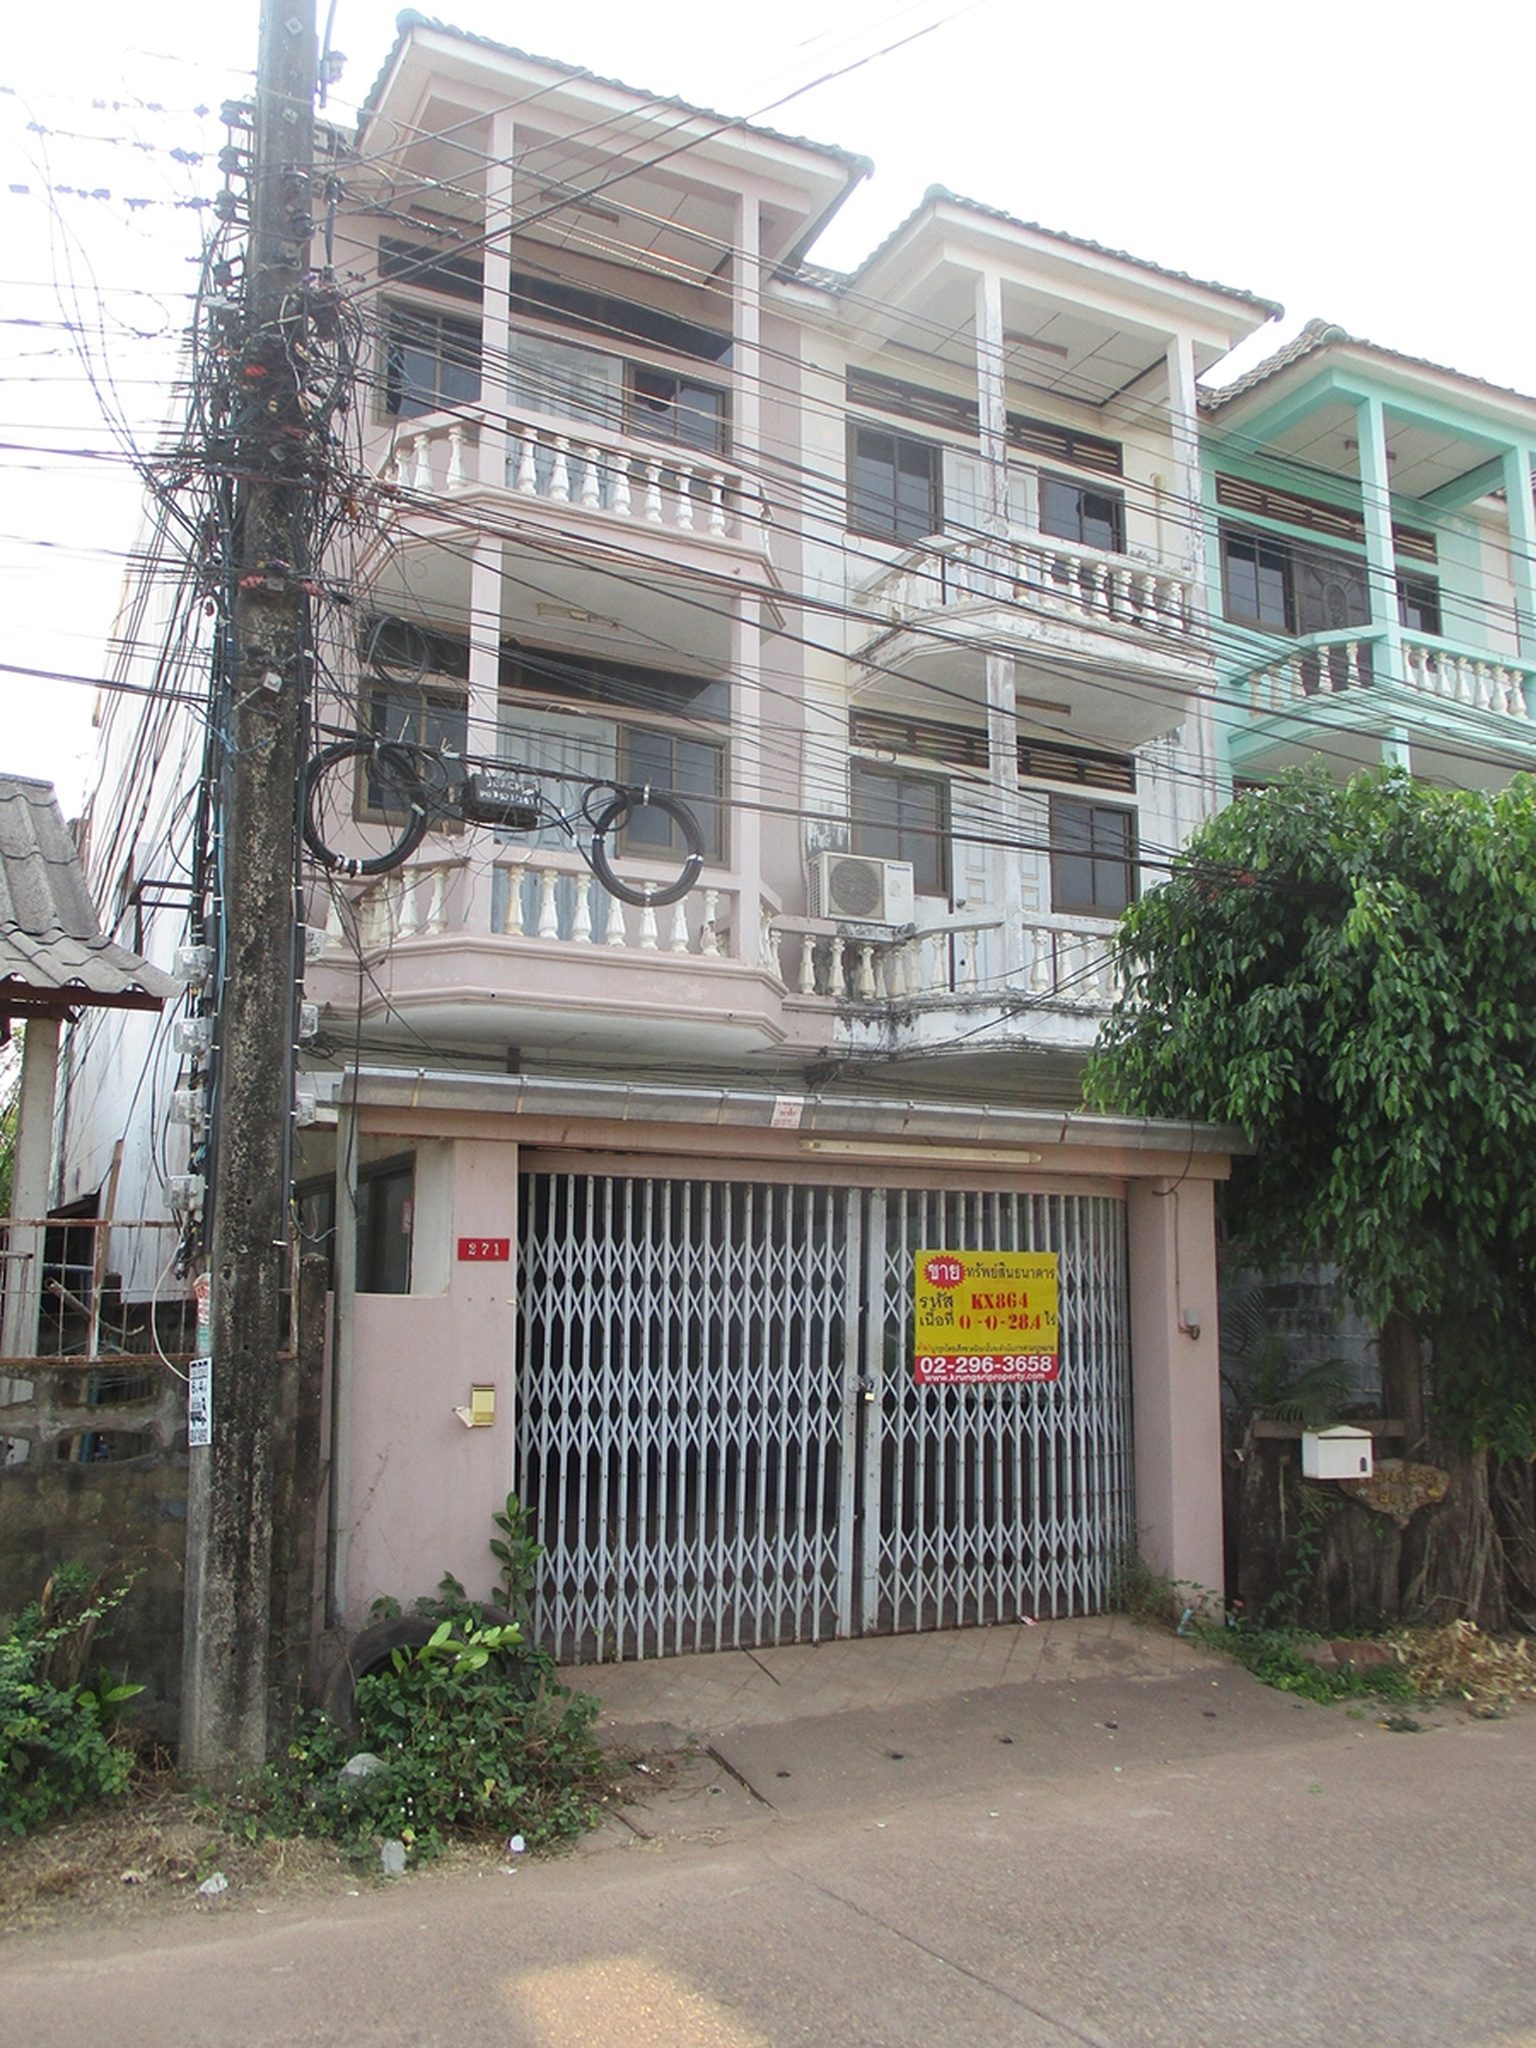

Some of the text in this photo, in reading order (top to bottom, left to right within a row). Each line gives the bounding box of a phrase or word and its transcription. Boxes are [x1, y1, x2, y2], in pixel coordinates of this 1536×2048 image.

[927, 1263, 960, 1281] ขาย
[919, 1291, 1028, 1310] รหัส KX864
[919, 1307, 954, 1326] เนื้อที่
[920, 1355, 1052, 1374] 02-296-3658
[924, 1373, 1045, 1382] www.krungsriproperty.com
